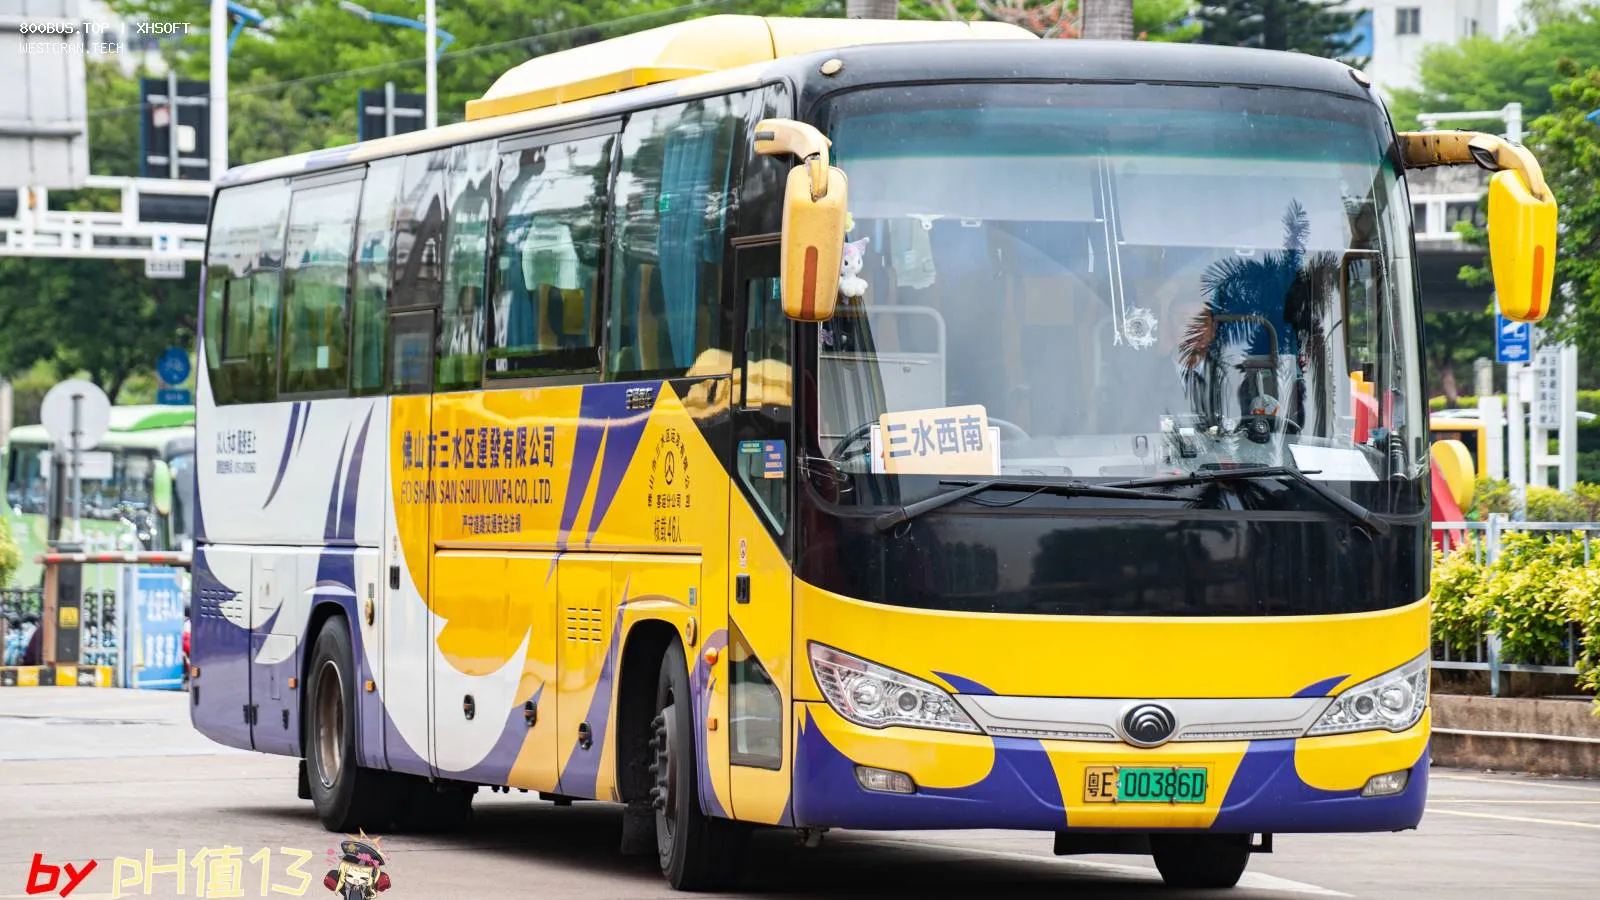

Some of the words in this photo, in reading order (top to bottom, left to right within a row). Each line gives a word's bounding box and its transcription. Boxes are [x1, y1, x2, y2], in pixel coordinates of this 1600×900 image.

[402, 426, 555, 471] 佛山市三水区運發有限公司
[887, 414, 983, 457] 三水西南
[414, 479, 437, 504] SHAN
[439, 479, 458, 504] SAN
[459, 479, 481, 504] SHUI
[482, 479, 512, 504] YUNFA
[461, 513, 522, 535] 严守道路交通安全法规
[654, 515, 682, 543] 核载46人
